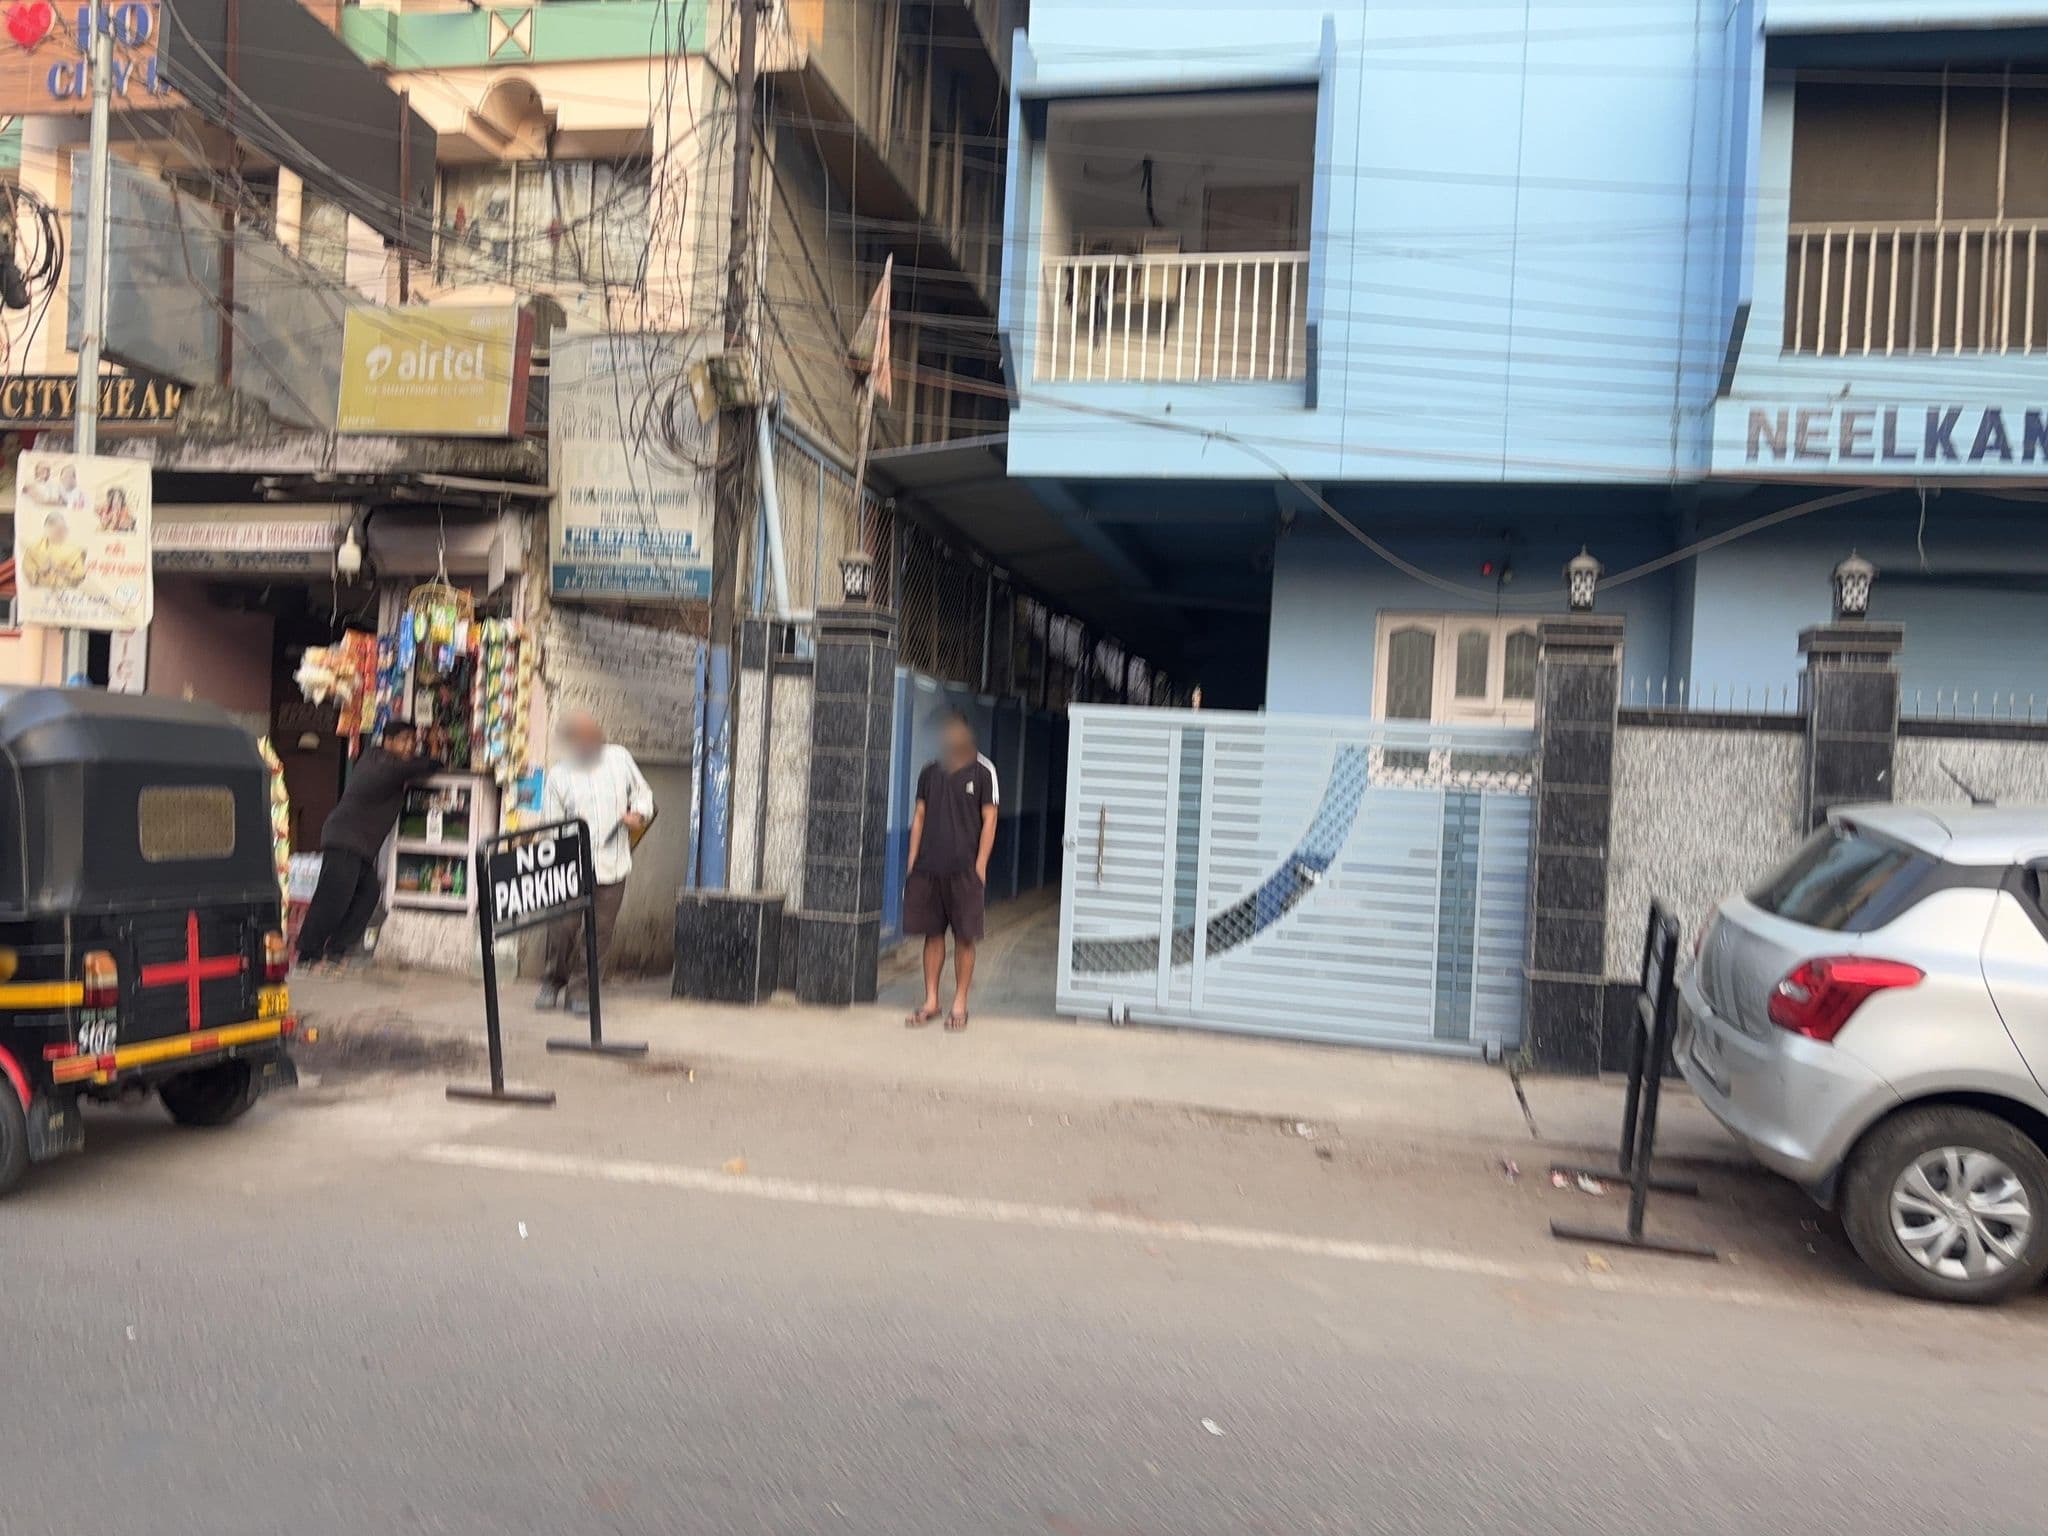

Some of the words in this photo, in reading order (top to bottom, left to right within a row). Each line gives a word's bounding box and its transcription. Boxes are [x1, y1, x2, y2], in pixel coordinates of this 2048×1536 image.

[47, 58, 134, 98] CIY
[398, 338, 486, 382] airtel
[2, 379, 77, 418] CITY
[583, 486, 612, 506] DTORS
[516, 839, 556, 875] NO
[495, 860, 579, 923] PARKING
